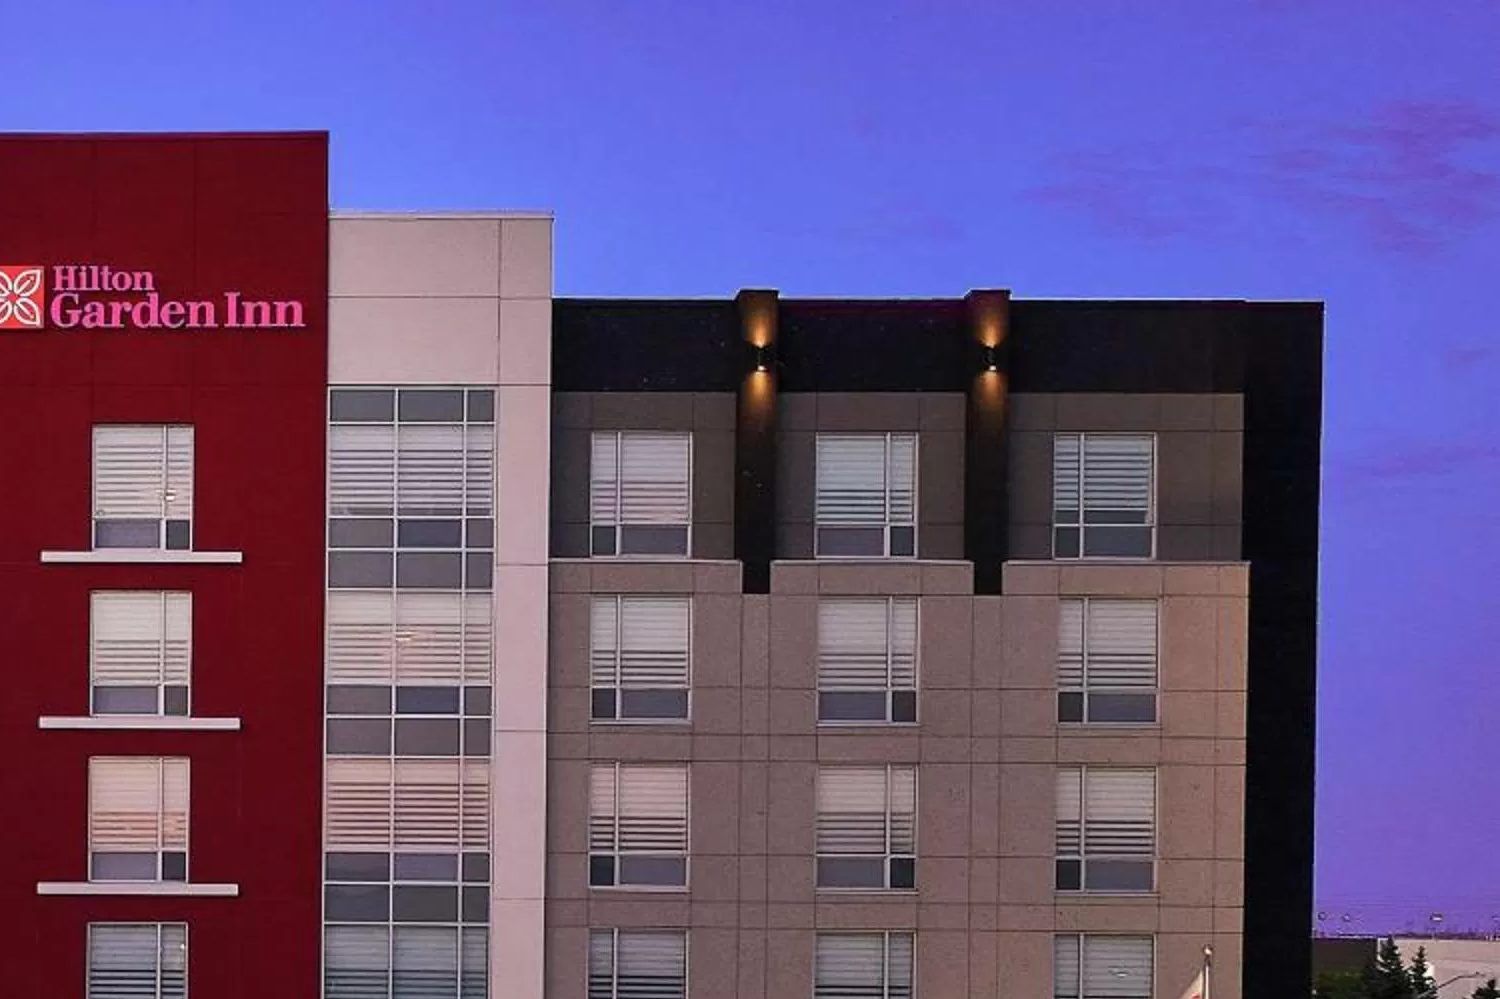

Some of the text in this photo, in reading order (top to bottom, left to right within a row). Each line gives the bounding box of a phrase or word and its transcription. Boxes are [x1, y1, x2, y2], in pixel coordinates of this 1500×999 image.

[52, 265, 155, 291] Hilton
[50, 291, 307, 328] Garden Inn
